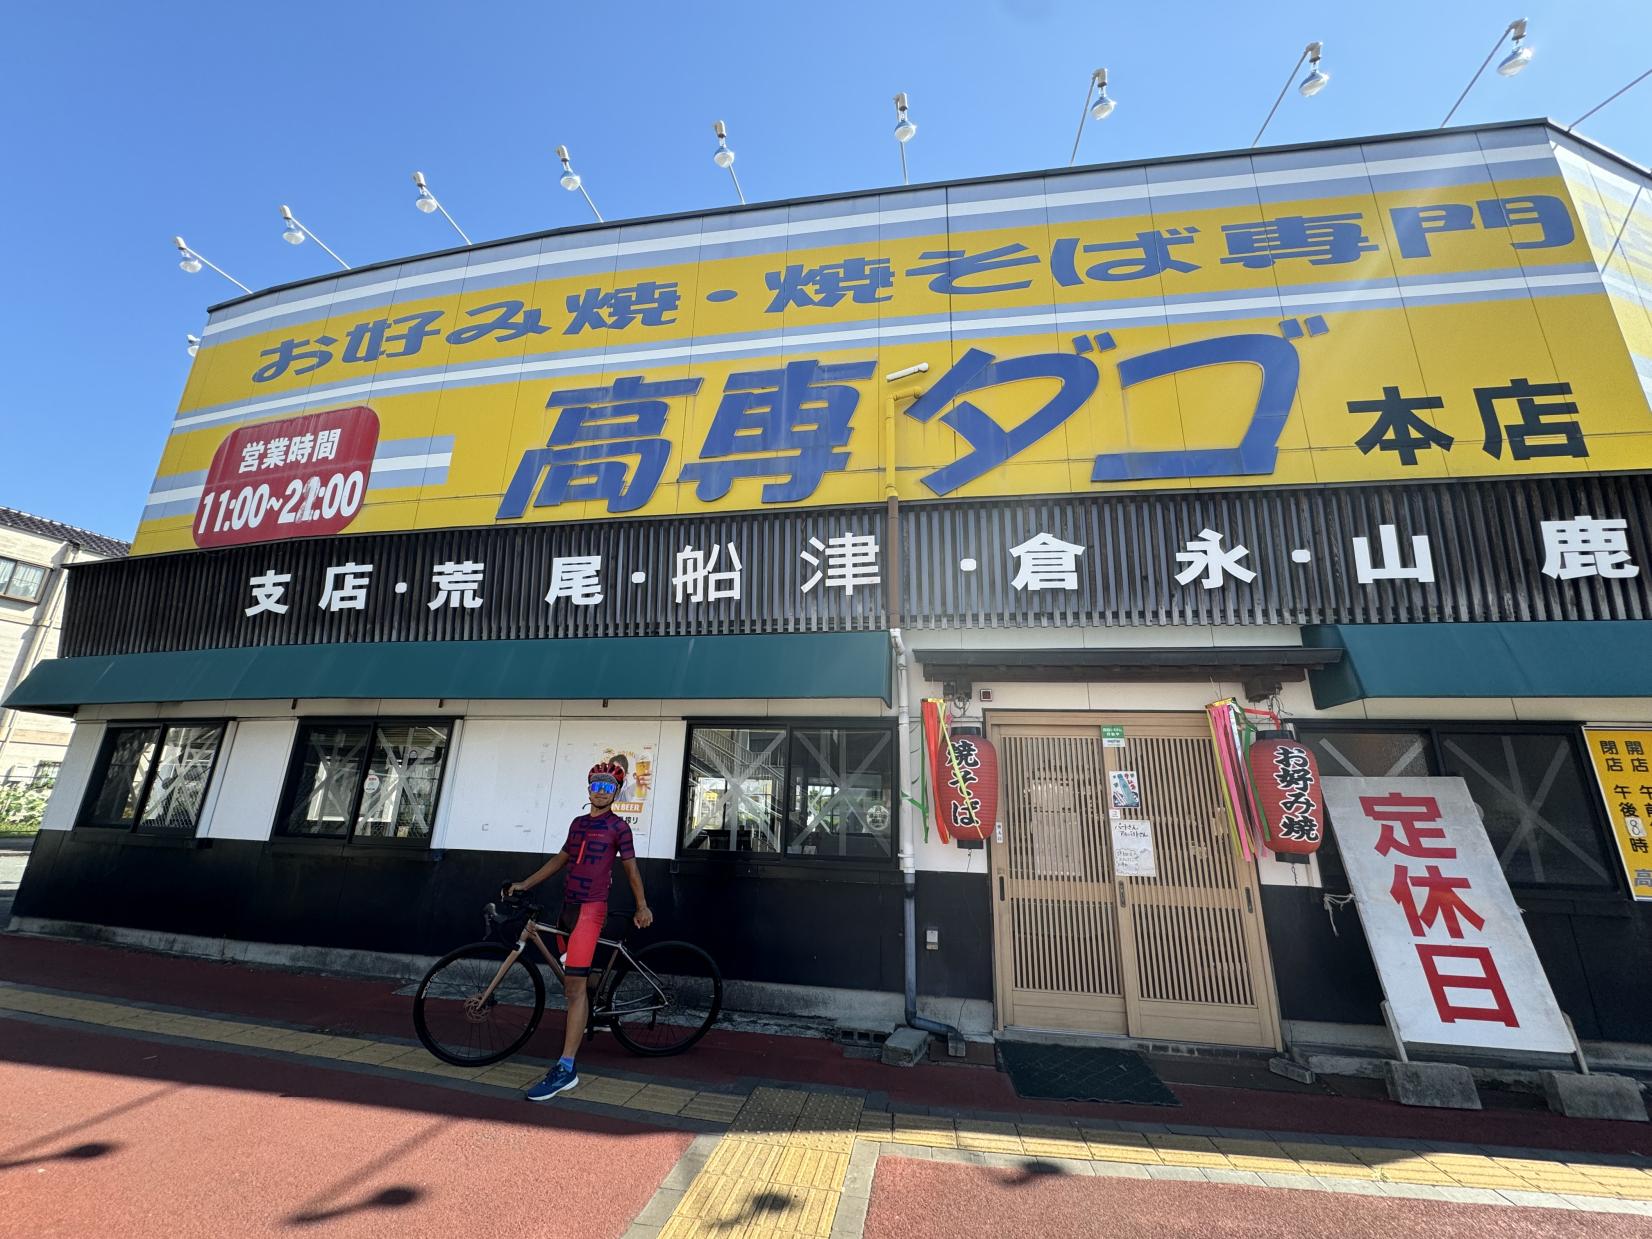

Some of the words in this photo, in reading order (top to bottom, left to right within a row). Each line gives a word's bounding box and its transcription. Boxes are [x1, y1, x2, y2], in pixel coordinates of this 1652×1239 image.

[252, 195, 1576, 384] お好み焼・焼そば専門
[239, 429, 341, 473] 営業時間
[495, 315, 1329, 520] 高専ダゴ
[1347, 378, 1589, 465] 本店
[945, 740, 980, 826] 焼そば
[1273, 746, 1320, 842] お好み焼
[1599, 741, 1623, 772] 閉店
[1625, 741, 1649, 773] 開店
[621, 803, 640, 811] BEER
[1358, 792, 1520, 1028] 定休日
